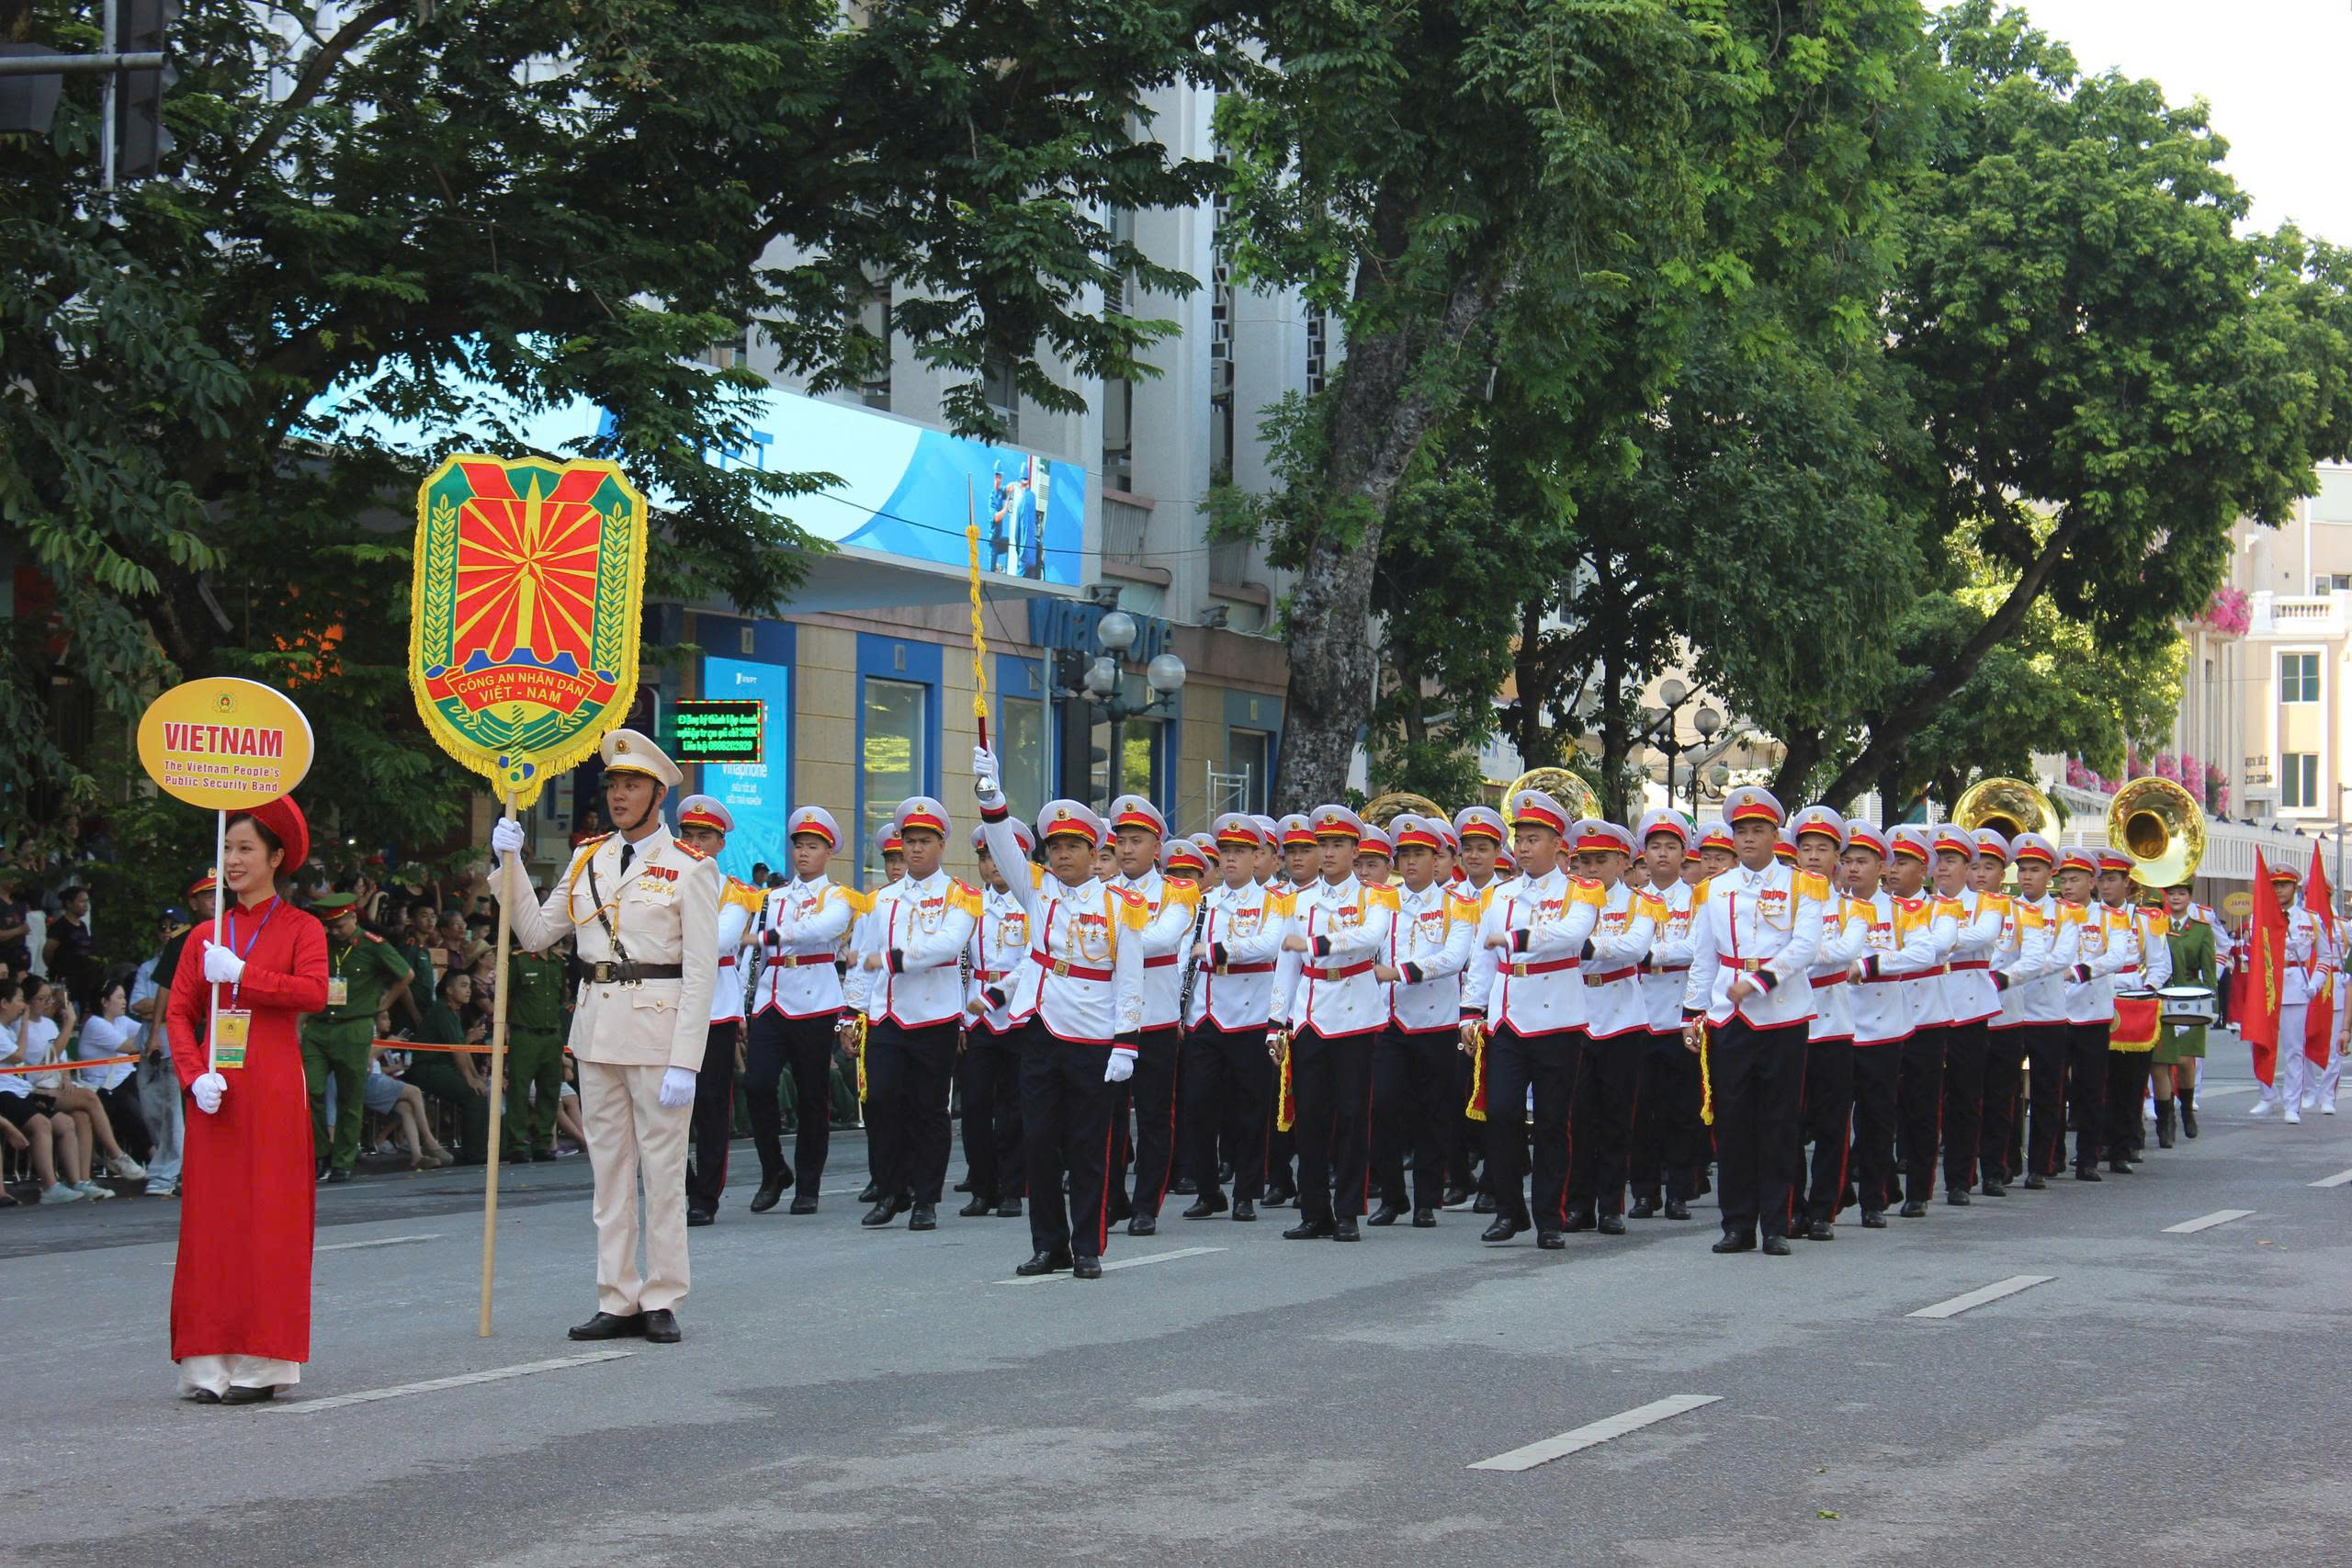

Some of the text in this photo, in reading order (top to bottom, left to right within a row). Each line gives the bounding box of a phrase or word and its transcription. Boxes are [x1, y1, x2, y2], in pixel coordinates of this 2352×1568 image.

[458, 671, 584, 697] CÔNG AN NHÂN DÂN
[479, 685, 512, 703] VIỆT
[526, 687, 561, 704] NAM
[164, 723, 284, 758] VIETNAM
[164, 761, 279, 778] The Vietnam People's
[165, 776, 278, 792] Public Security Band
